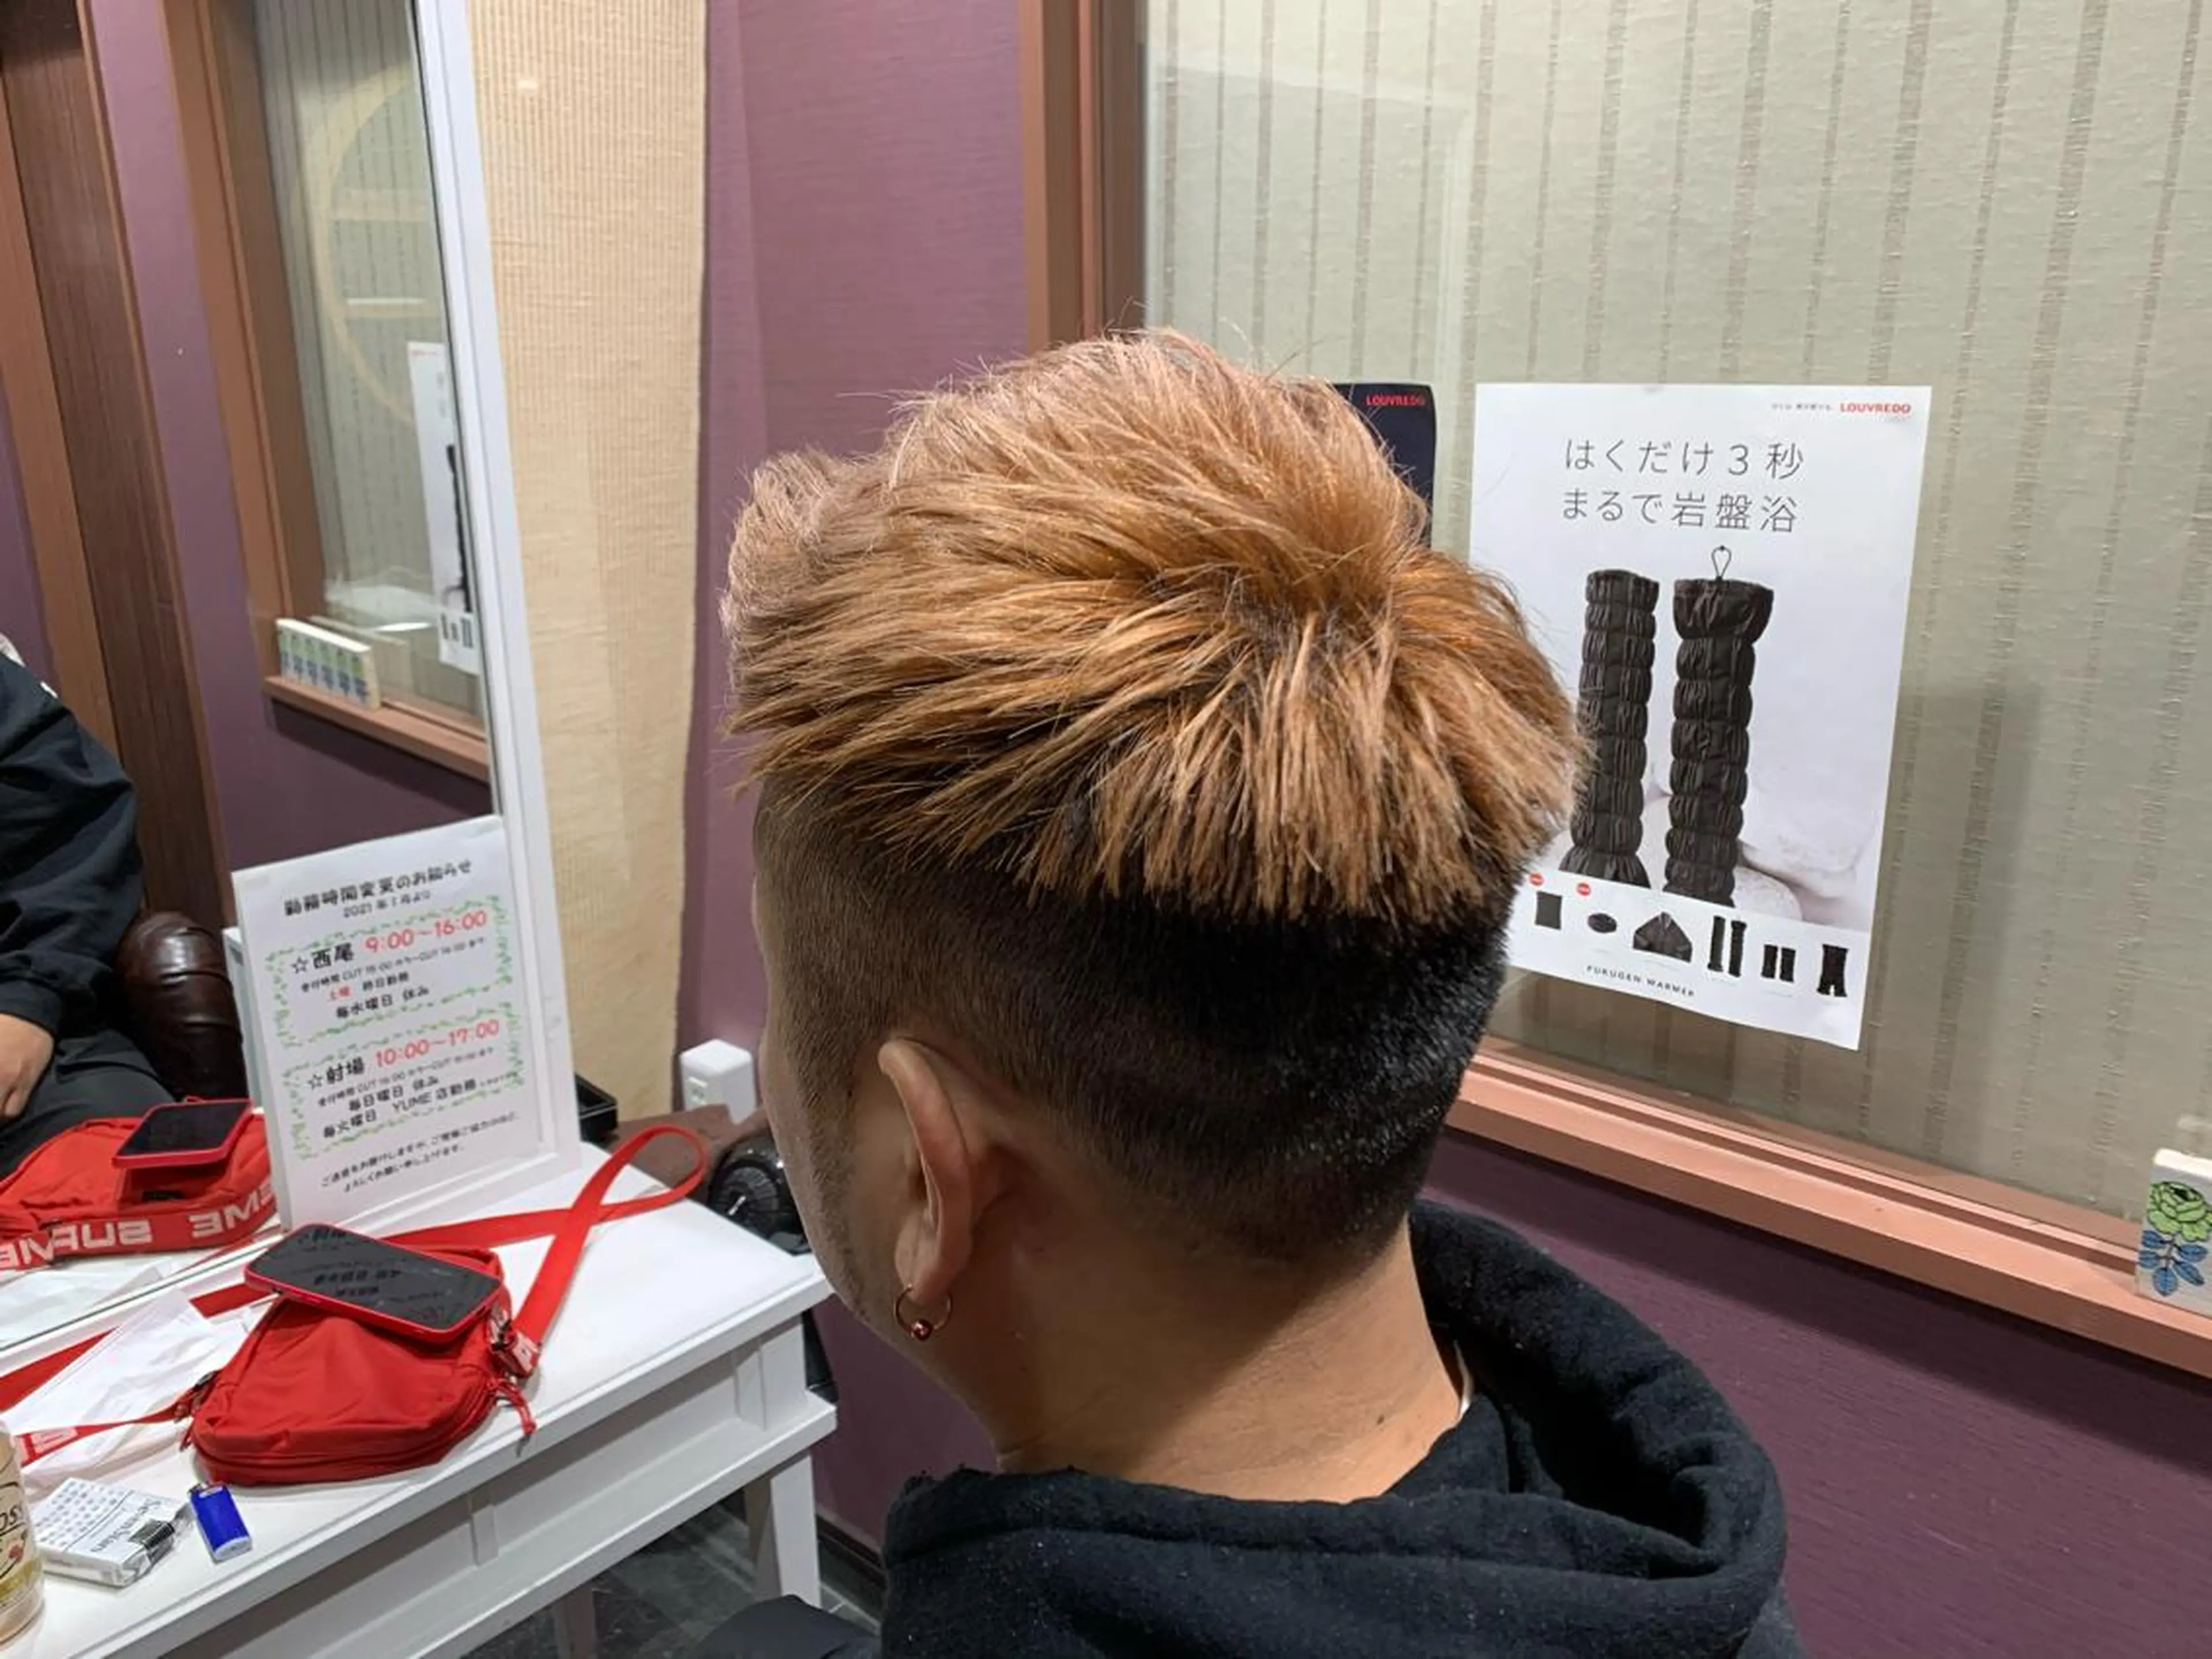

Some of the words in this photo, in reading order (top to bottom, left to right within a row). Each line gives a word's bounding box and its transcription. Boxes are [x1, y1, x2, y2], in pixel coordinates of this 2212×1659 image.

[1839, 402, 1911, 414] LOUVREDO
[1562, 488, 1798, 533] まるで岩盤浴
